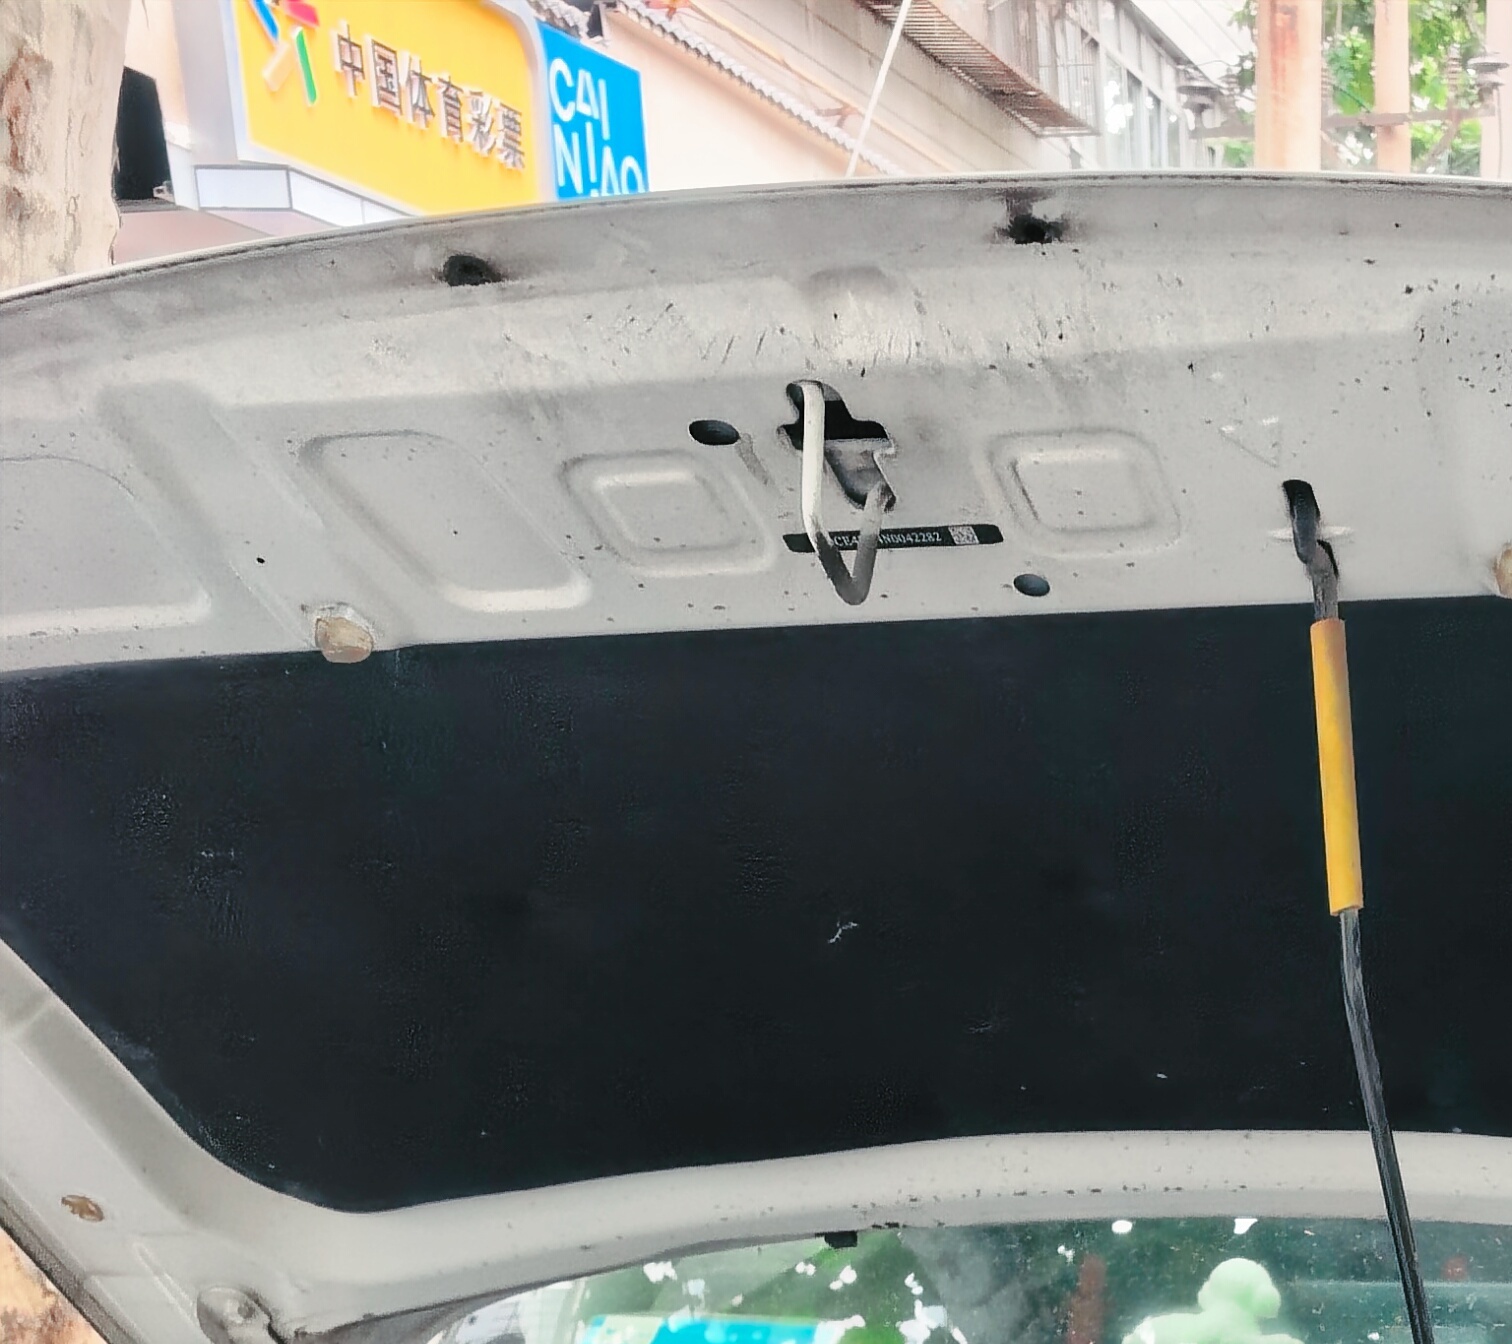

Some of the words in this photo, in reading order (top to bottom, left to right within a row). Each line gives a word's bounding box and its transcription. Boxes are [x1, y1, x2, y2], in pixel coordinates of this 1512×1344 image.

[330, 19, 526, 171] 中国体育彩票
[549, 57, 610, 141] CAI
